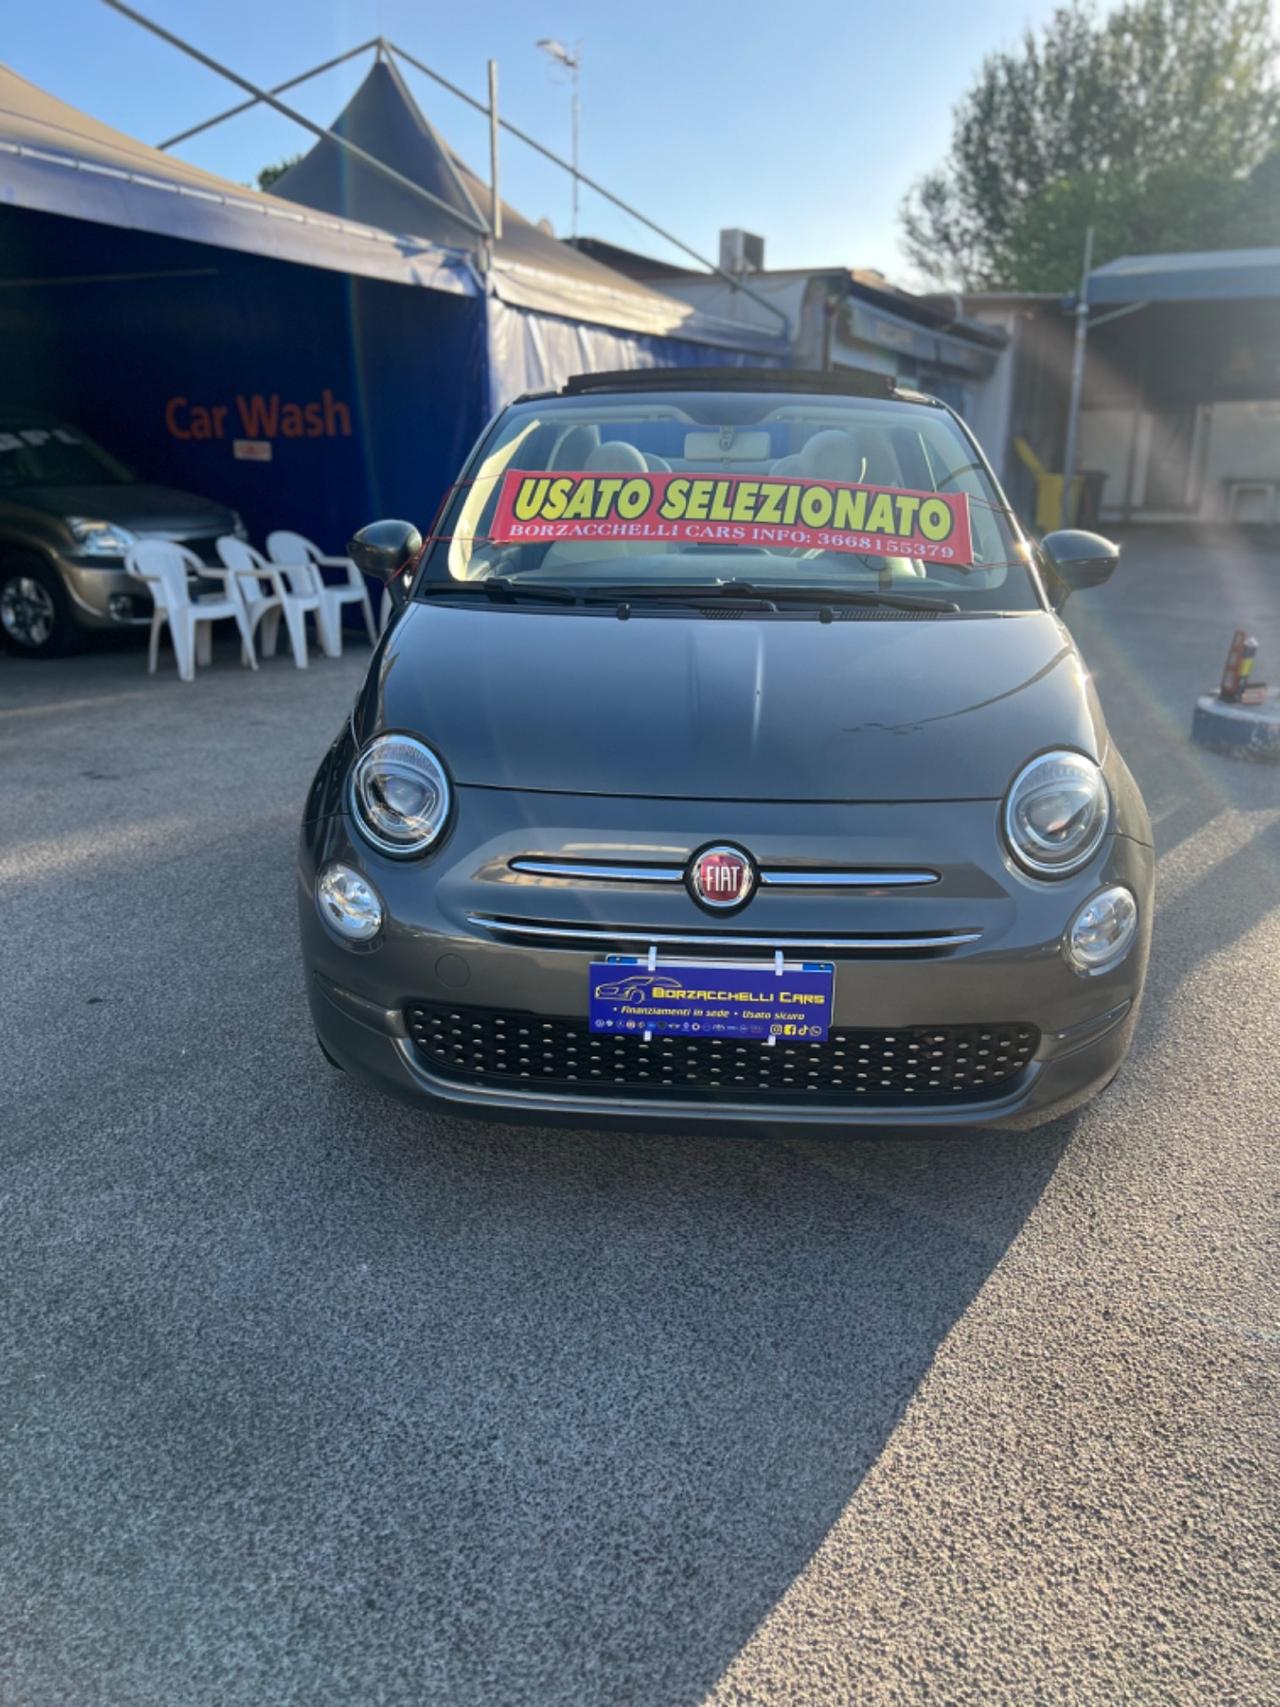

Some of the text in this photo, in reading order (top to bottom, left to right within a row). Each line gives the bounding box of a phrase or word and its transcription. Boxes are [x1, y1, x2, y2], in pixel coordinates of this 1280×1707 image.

[165, 389, 351, 440] Car Wash
[513, 477, 954, 543] USATO SELEZIONATO
[509, 524, 954, 559] BORZACCHELLI CARS INFO: 3668155379
[706, 866, 740, 892] FIAT
[705, 1009, 730, 1018] sede
[742, 1010, 771, 1019] Usato
[774, 1012, 805, 1020] sicuro
